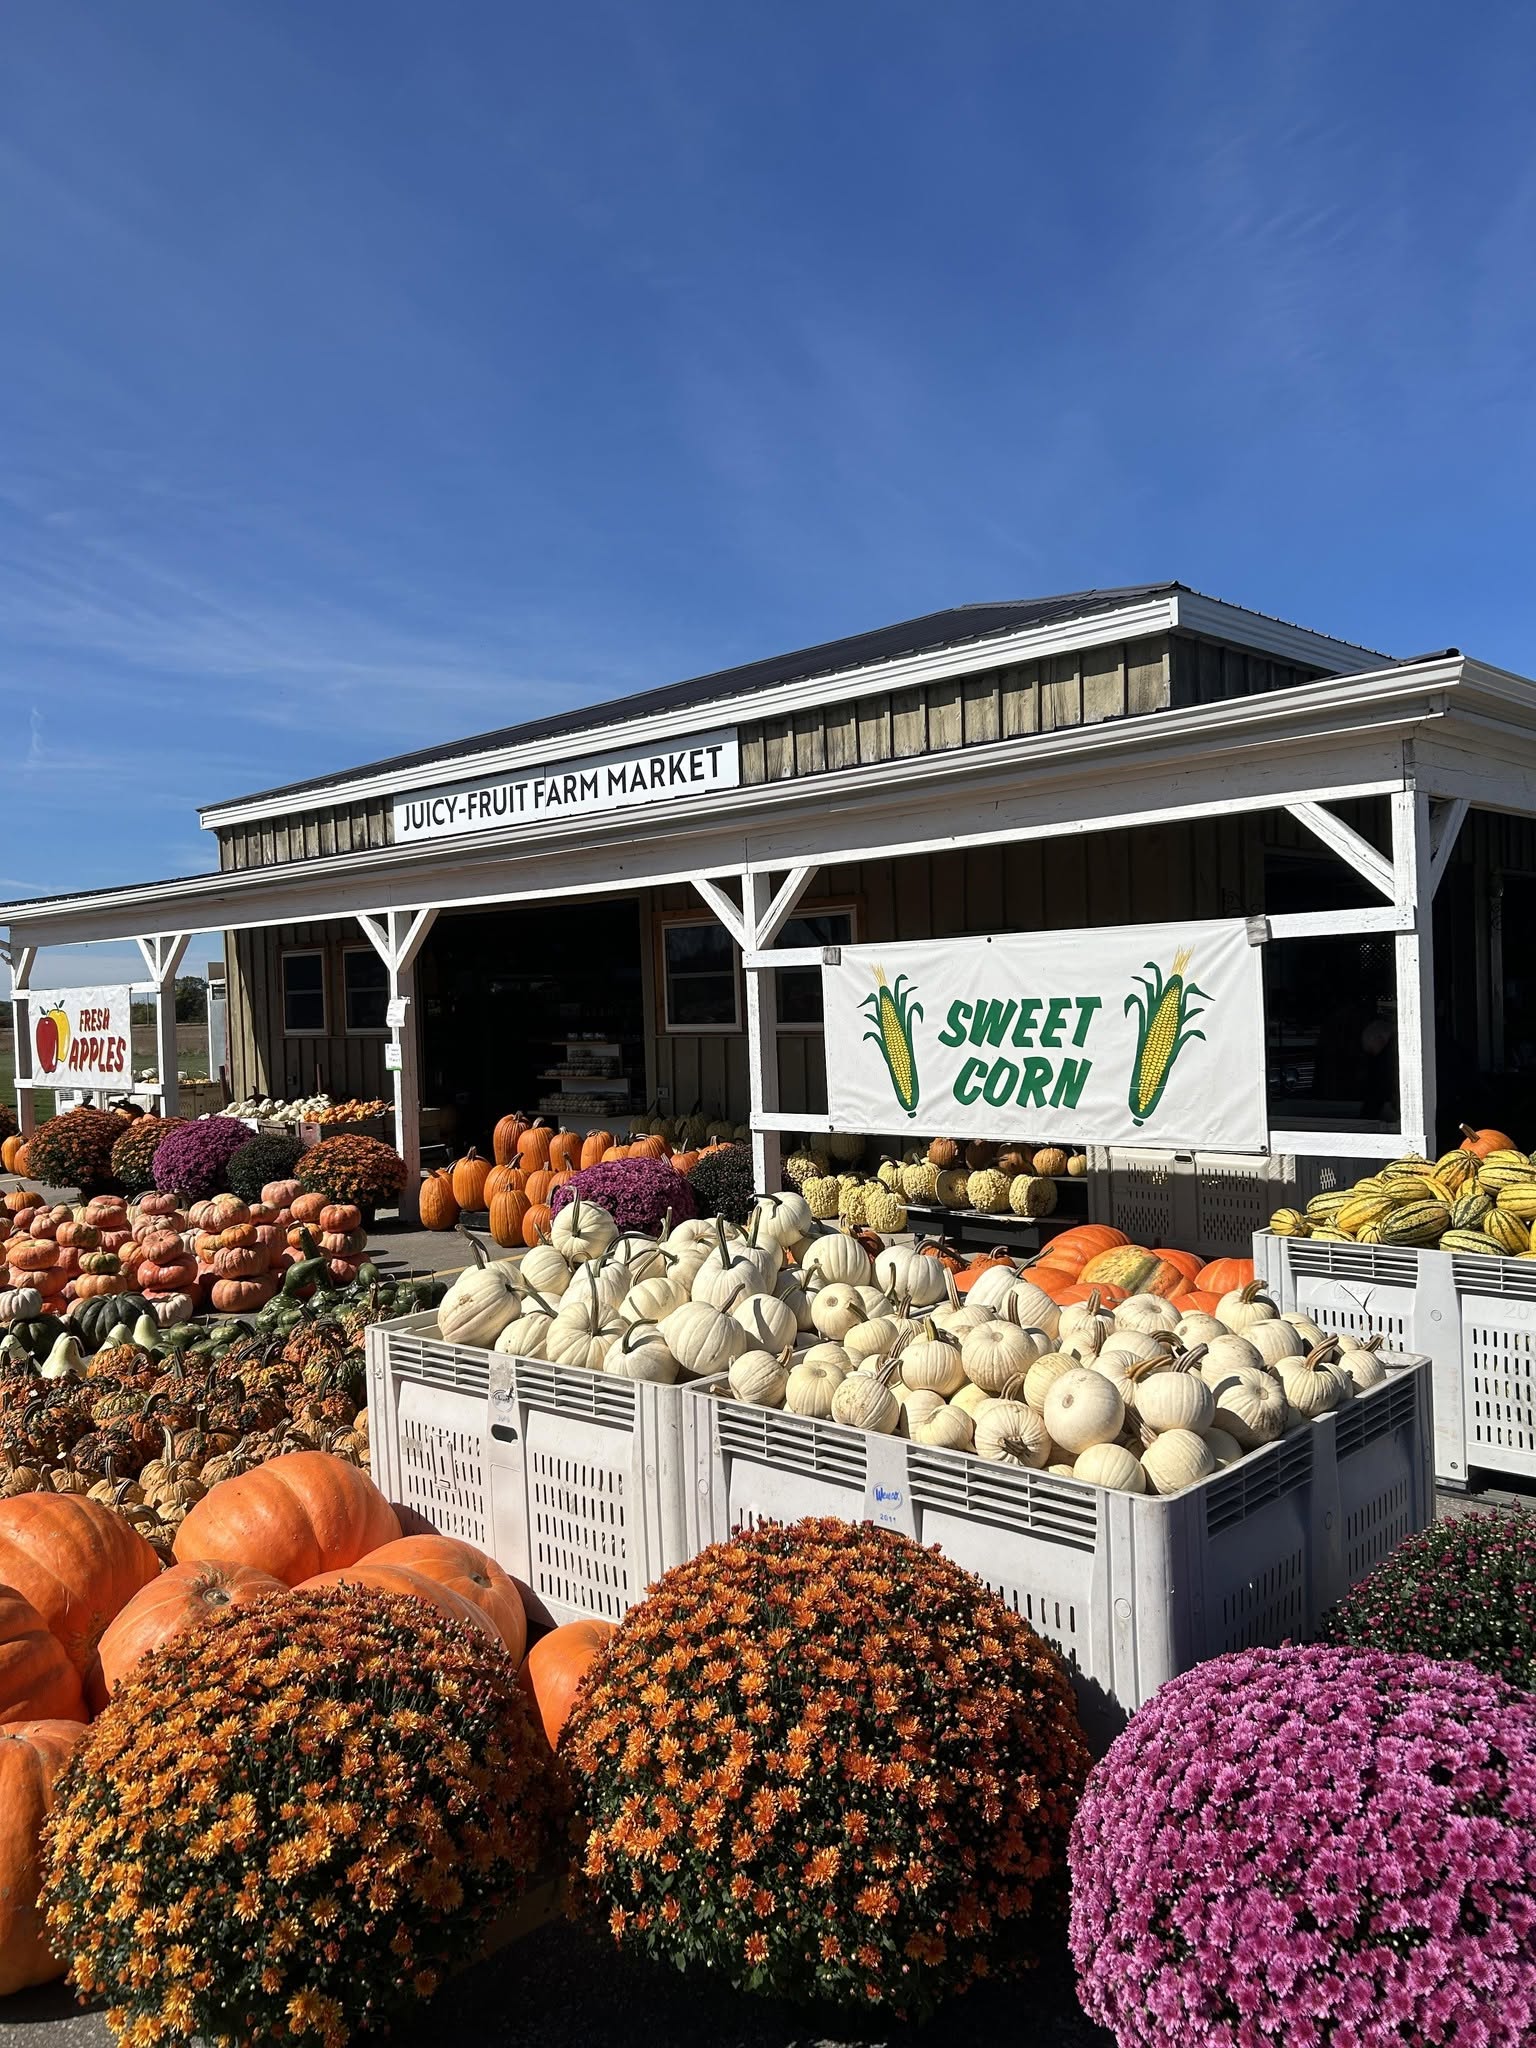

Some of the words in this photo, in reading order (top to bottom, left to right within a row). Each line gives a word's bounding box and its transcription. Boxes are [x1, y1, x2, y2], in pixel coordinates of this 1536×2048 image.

[403, 783, 529, 832] JUICY-FRUIT
[534, 770, 598, 809] FARM
[607, 745, 723, 796] MARKET
[79, 1007, 110, 1032] FRESH
[938, 996, 1102, 1048] SWEET
[68, 1036, 127, 1073] APPLES
[952, 1056, 1092, 1110] CORN
